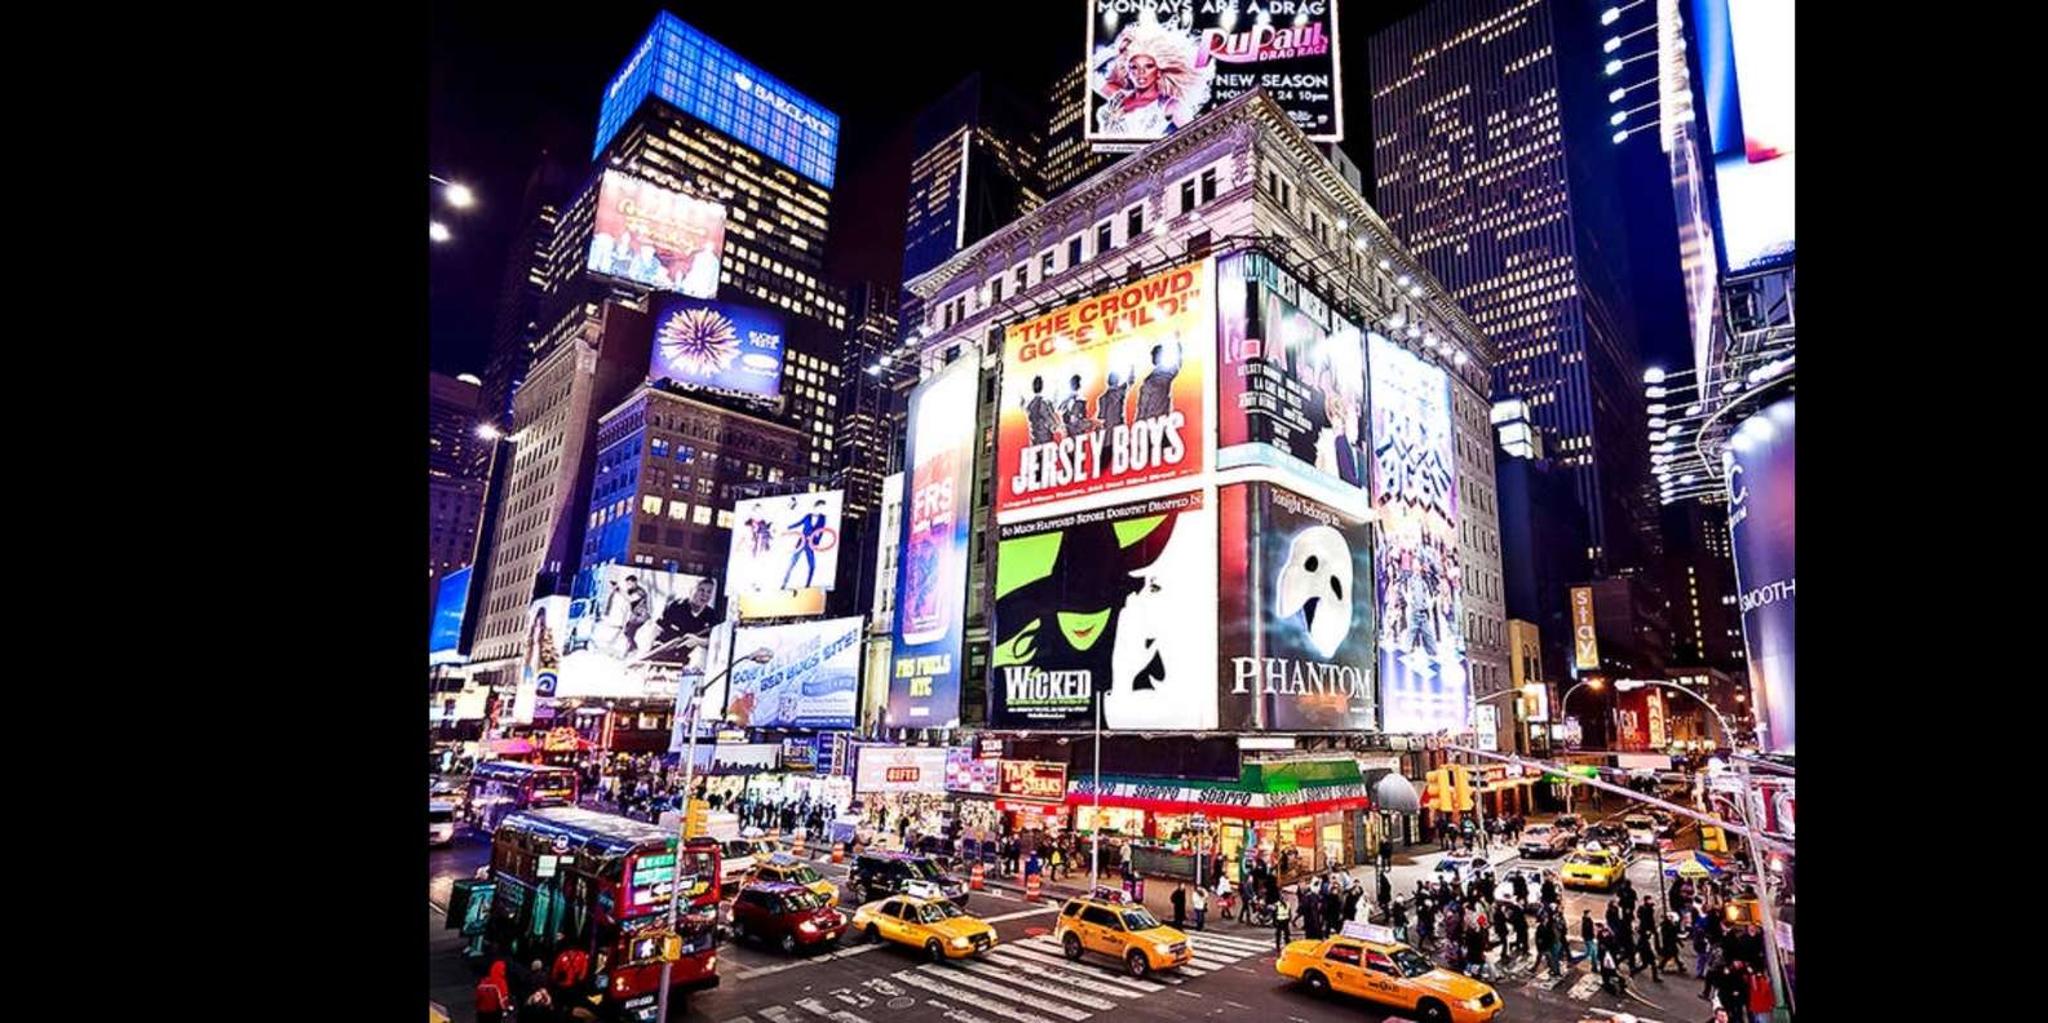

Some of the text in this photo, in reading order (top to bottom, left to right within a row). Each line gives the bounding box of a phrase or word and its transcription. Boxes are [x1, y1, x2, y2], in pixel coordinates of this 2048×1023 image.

[1201, 0, 1240, 14] ARE
[1247, 0, 1263, 14] A
[1270, 0, 1324, 15] DRAG
[1260, 44, 1328, 61] DRAG RACE
[1216, 74, 1328, 88] NEW SEASON
[1277, 90, 1293, 100] 24
[1299, 90, 1328, 102] 10pm
[754, 83, 832, 137] BARCLAYS
[1078, 269, 1194, 325] CROWD
[1011, 429, 1107, 496] JERSEY
[1112, 411, 1186, 476] BOYS
[1271, 488, 1302, 514] Tonight
[1302, 499, 1332, 525] belongs
[1231, 656, 1372, 700] PHANTOM
[1133, 783, 1180, 800] sbarro
[1198, 786, 1252, 806] sbarro
